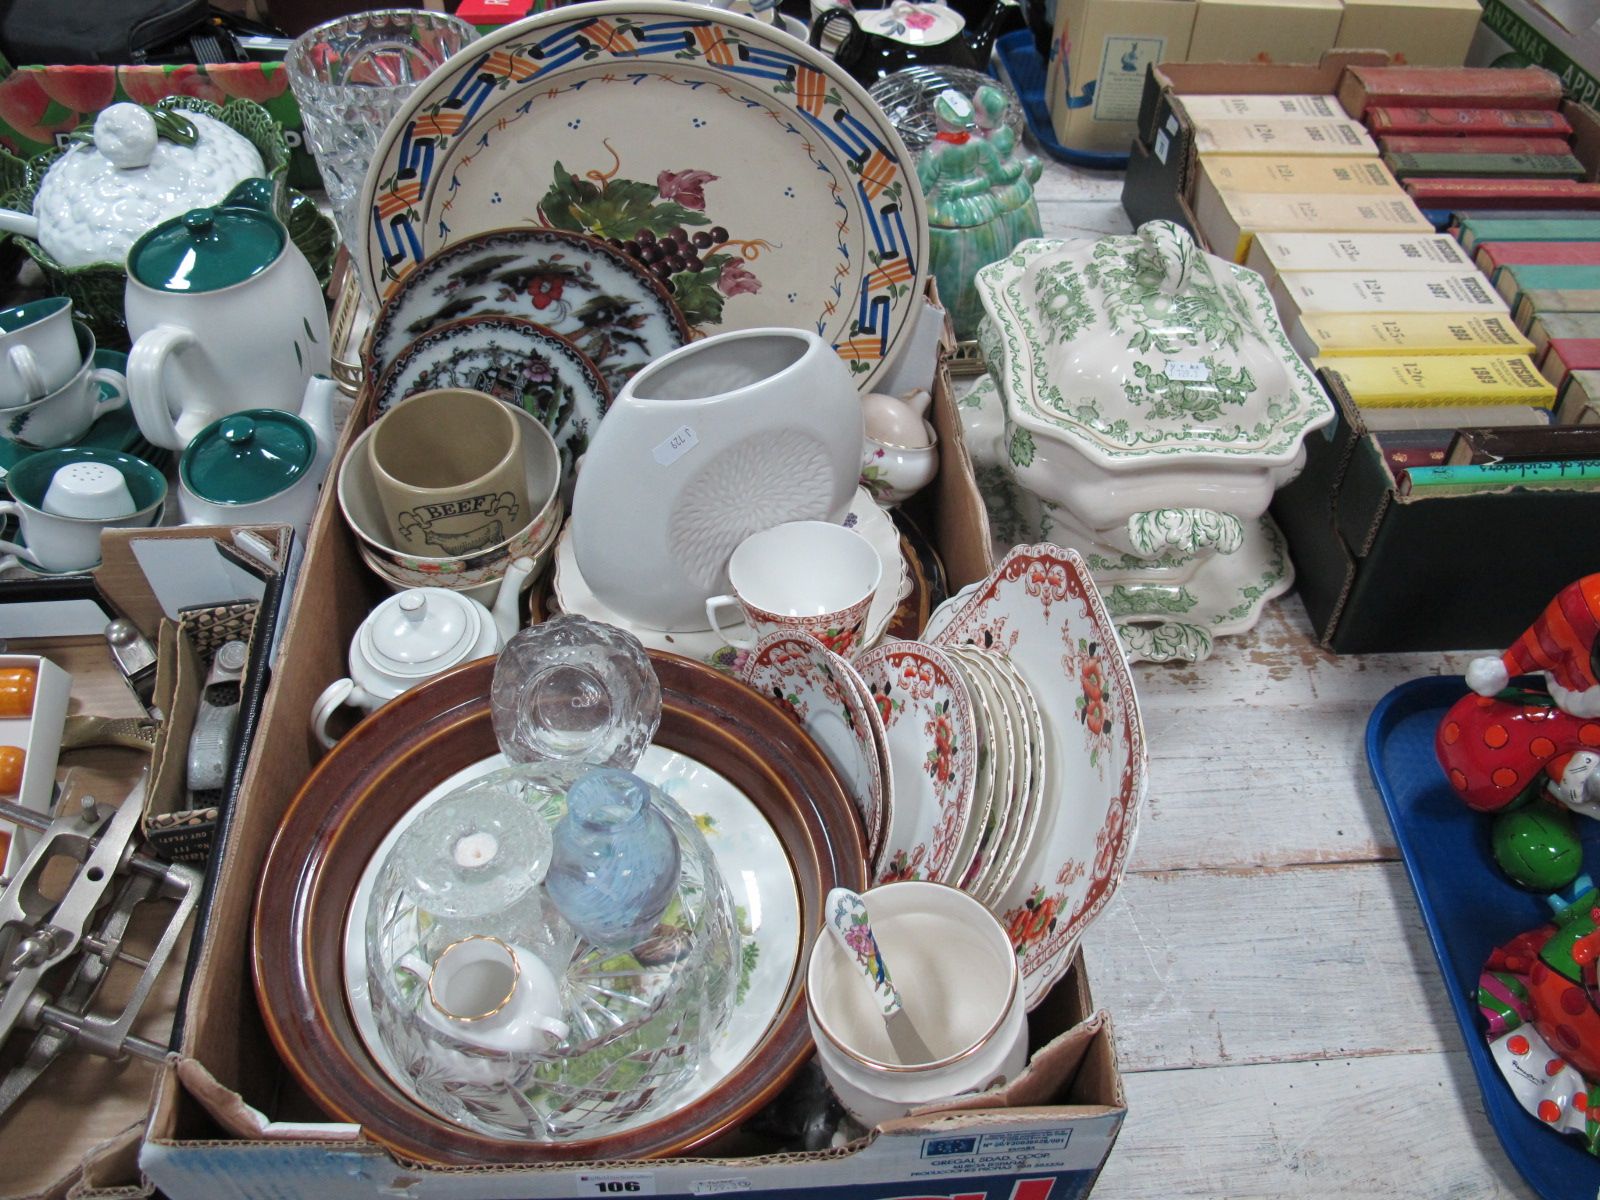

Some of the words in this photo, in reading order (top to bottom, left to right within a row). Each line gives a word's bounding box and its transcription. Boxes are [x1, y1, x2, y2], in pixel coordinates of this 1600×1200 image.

[1485, 2, 1548, 63] ANZANAS
[1432, 239, 1464, 263] WISDEN
[1426, 283, 1451, 299] 1987
[1460, 276, 1494, 304] WISDEN
[1448, 326, 1473, 341] 1988
[1482, 318, 1519, 345] WISDEN
[1471, 366, 1498, 384] 1989
[1506, 358, 1545, 388] WISDEN
[1575, 459, 1600, 476] ook
[426, 496, 486, 519] BEEF
[930, 1157, 974, 1167] GREGAL
[594, 1181, 640, 1193] 106
